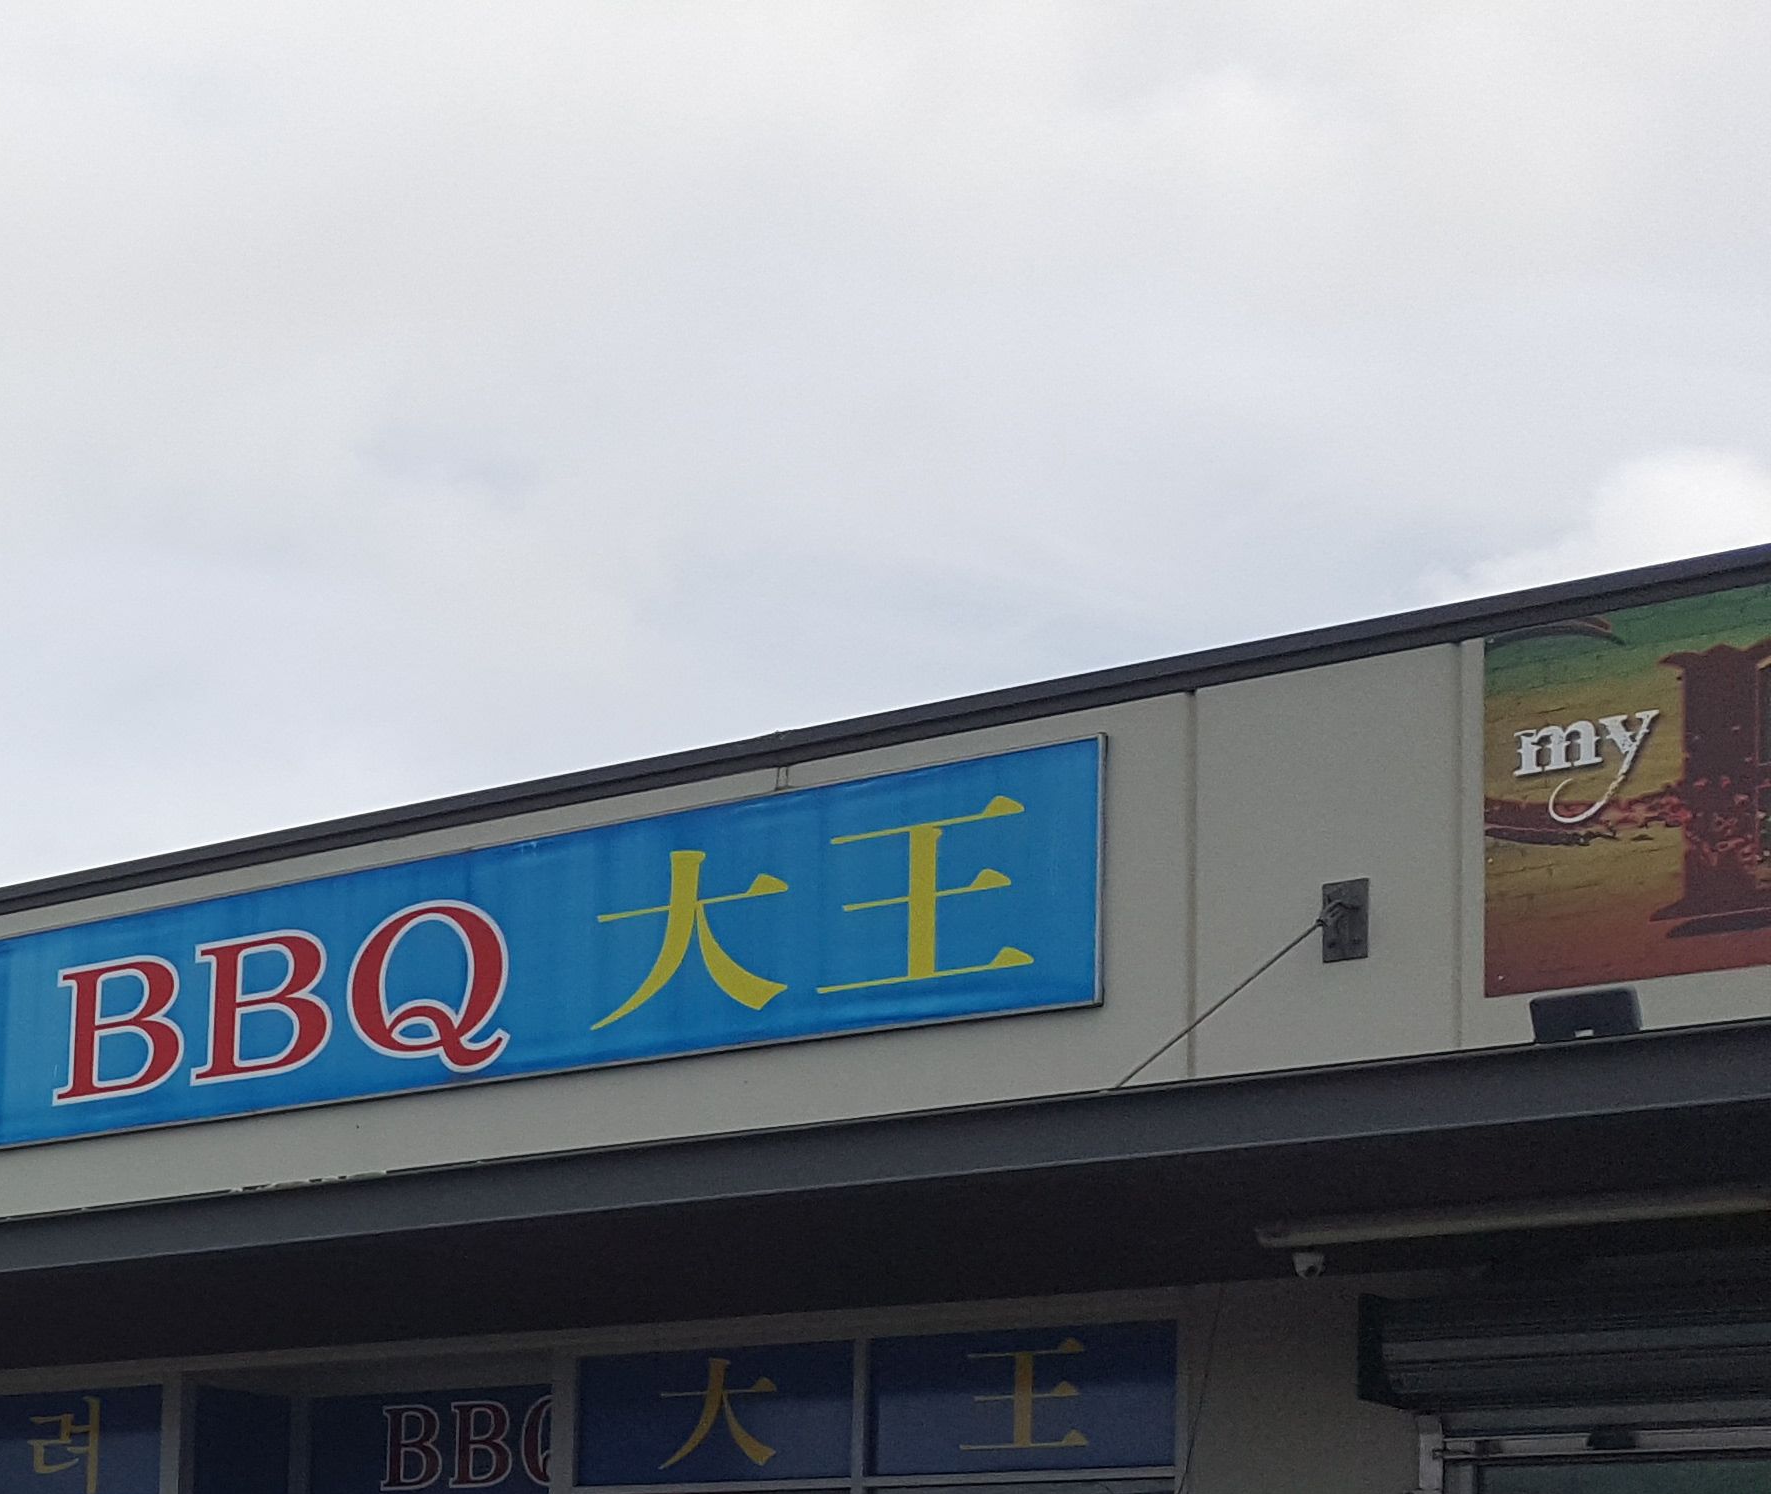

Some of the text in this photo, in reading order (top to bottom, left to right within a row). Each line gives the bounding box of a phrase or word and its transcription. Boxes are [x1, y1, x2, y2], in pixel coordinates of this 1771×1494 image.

[1514, 709, 1660, 824] my
[52, 897, 512, 1106] BBQ
[589, 794, 1036, 1030] 大王
